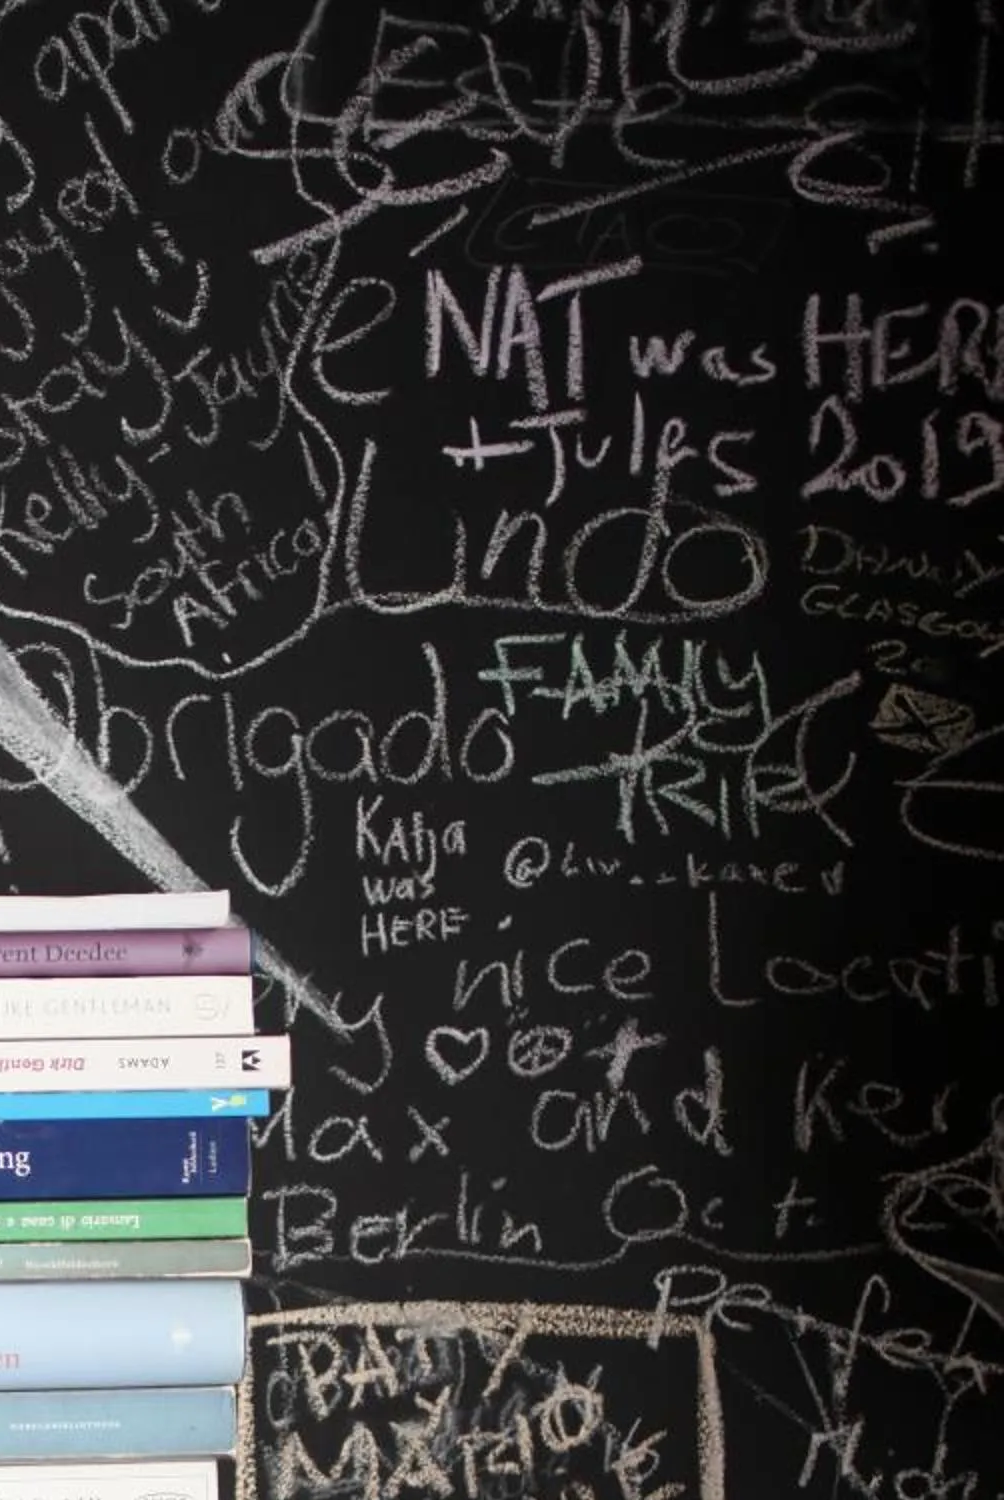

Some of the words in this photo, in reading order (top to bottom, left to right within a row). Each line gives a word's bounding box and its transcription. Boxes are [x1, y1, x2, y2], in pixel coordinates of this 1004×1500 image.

[426, 255, 643, 411] NAT
[630, 330, 777, 384] was
[45, 942, 129, 963] Deedee
[43, 996, 173, 1017] GENTLEMAN
[49, 1057, 86, 1072] Dirk
[118, 1056, 170, 1069] ADAMS
[531, 1047, 733, 1157] and
